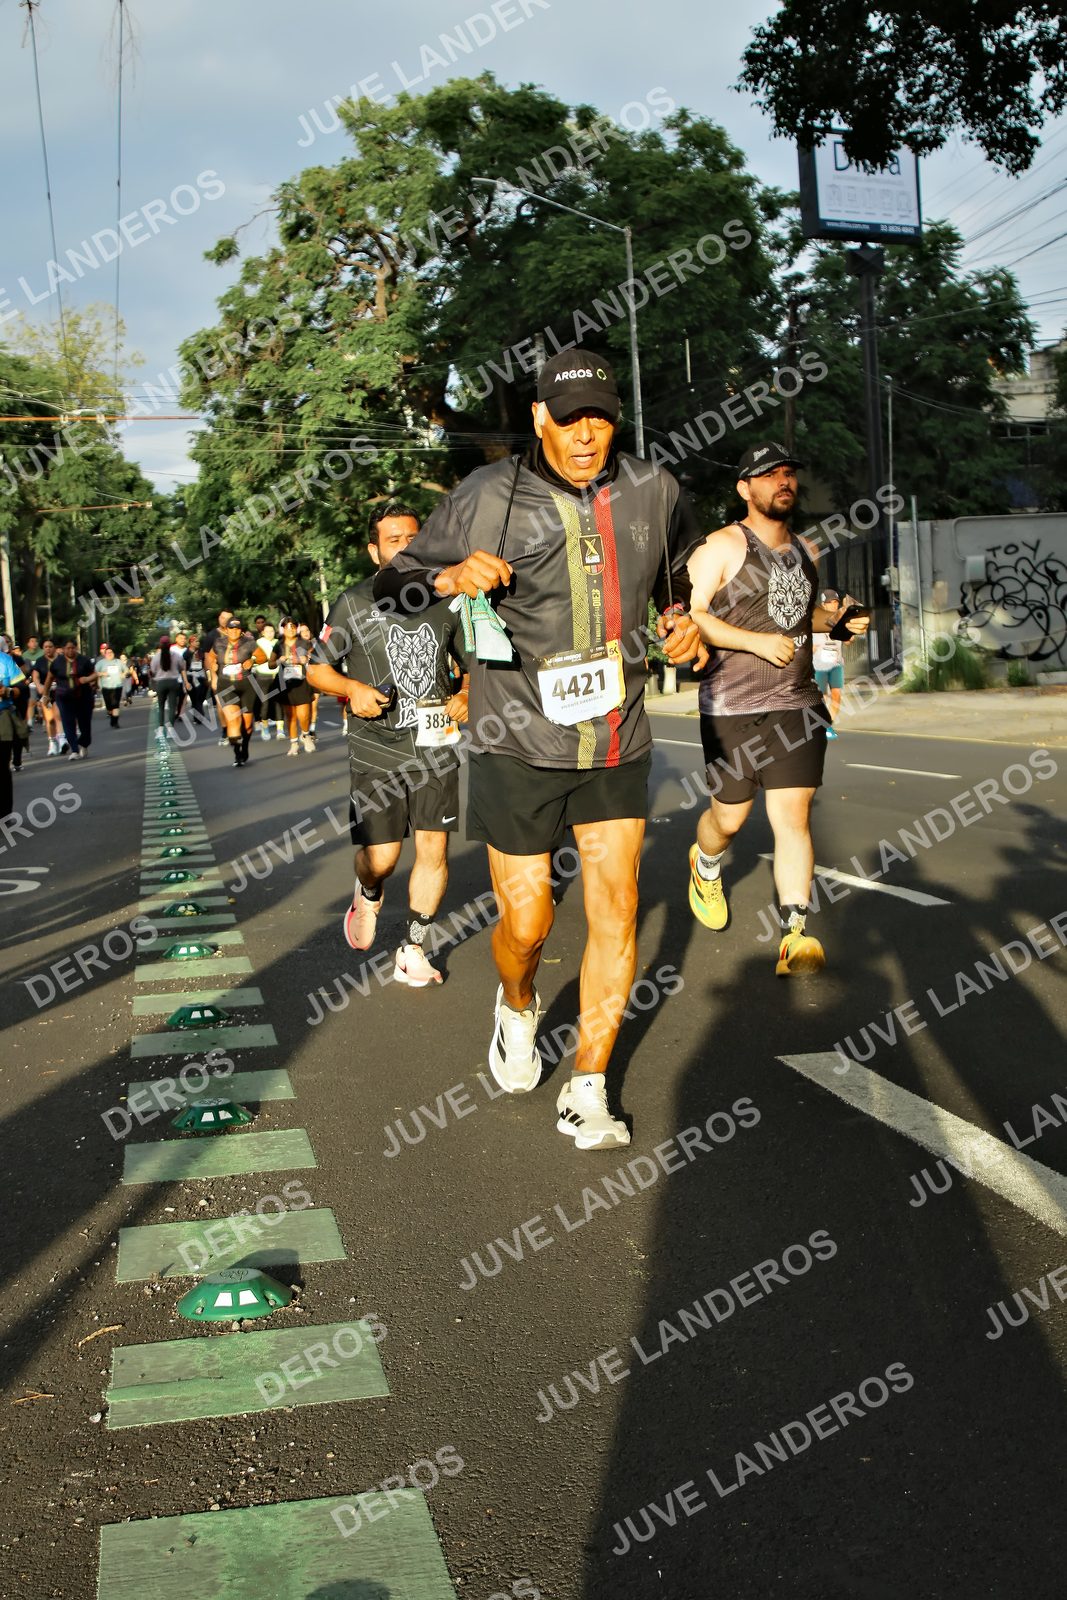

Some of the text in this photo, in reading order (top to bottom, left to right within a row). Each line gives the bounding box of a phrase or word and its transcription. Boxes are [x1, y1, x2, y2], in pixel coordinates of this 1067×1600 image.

[554, 368, 593, 382] ARGOS
[986, 539, 1041, 560] TOY
[552, 669, 606, 701] 4421
[426, 713, 451, 730] 3834
